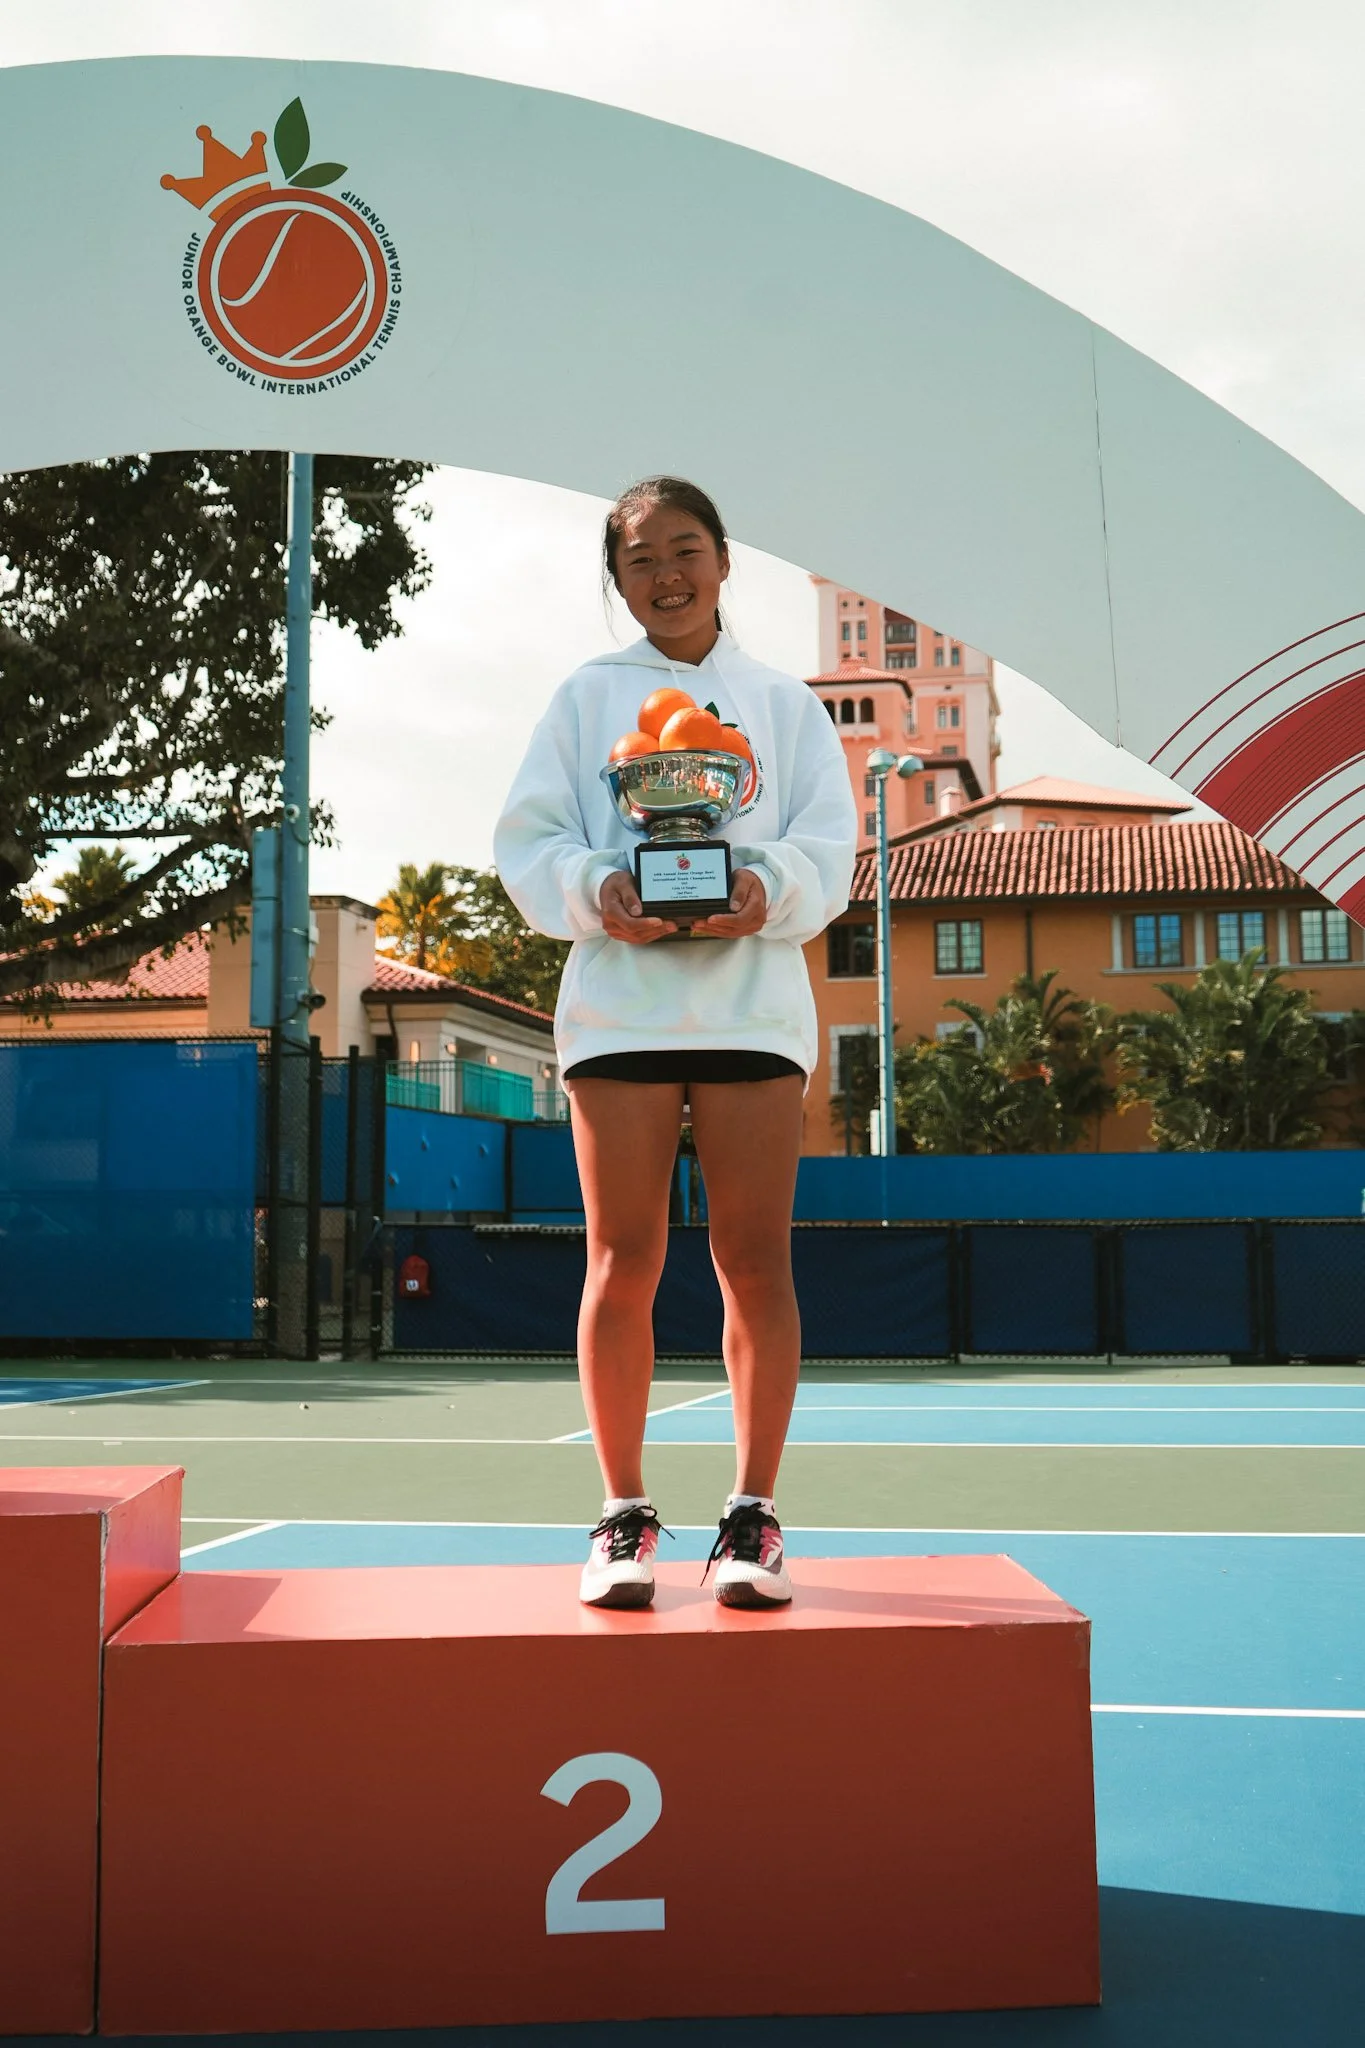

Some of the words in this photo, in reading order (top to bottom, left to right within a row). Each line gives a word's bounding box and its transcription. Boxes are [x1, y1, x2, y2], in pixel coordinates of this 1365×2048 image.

[181, 232, 201, 290] JUNIOR
[340, 190, 402, 295] CHAMPIONSHIP
[183, 294, 219, 355] ORANGE
[372, 298, 401, 351] TENNIS
[216, 354, 256, 387] BOWL
[260, 353, 376, 395] INTERNATIONAL
[754, 783, 764, 804] TENNIS
[540, 1752, 666, 1935] 2
